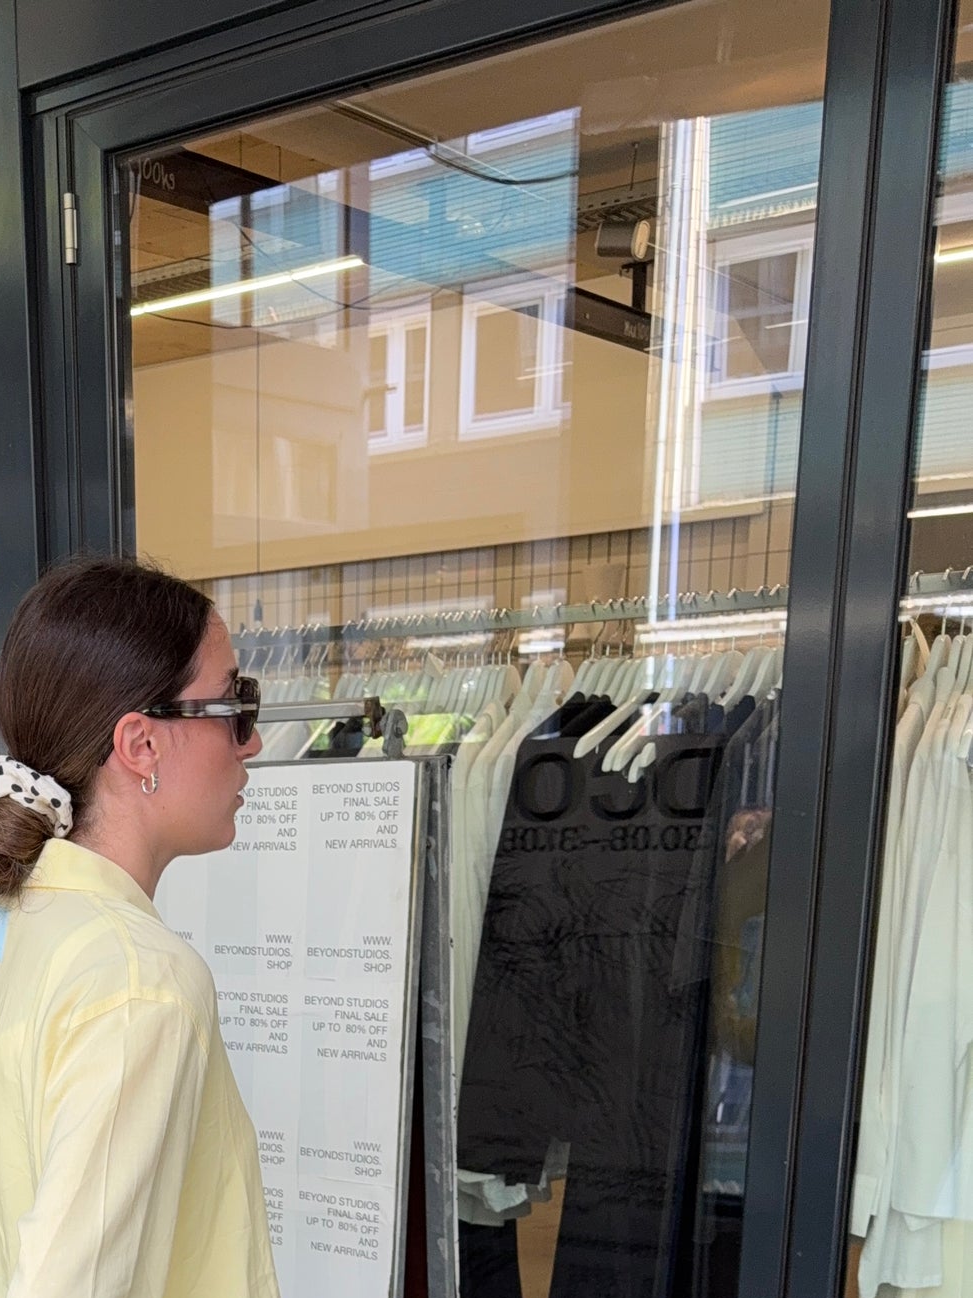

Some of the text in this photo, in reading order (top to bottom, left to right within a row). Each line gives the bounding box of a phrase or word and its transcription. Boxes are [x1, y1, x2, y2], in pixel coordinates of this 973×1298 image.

[256, 786, 298, 798] STUDIOS
[312, 781, 400, 794] BEYOND STUDIOS
[246, 800, 298, 811] FINAL SALE
[343, 796, 399, 808] FINAL SALE
[240, 814, 253, 825] TO
[256, 814, 277, 825] 80%
[278, 813, 298, 824] OFF
[320, 810, 399, 822] UP TO 80% OFF
[276, 827, 298, 838] AND
[376, 824, 398, 835] AND
[252, 840, 297, 851] ARRIVALS
[325, 838, 397, 849] NEW ARRIVALS
[265, 934, 293, 944] WWW.
[363, 936, 393, 946] WWW.
[214, 944, 293, 957] BEYONDSTUDIOS.
[307, 947, 392, 960] BEYONDSTUDIOS.
[267, 960, 292, 970] SHOP
[363, 962, 392, 973] SHOP
[217, 991, 289, 1004] EYOND STUDIOS
[304, 995, 389, 1009] BEYOND STUDIOS
[239, 1004, 288, 1017] FINAL SALE
[334, 1010, 389, 1022] FINAL SALE
[219, 1016, 288, 1029] UP TO 80% OFF
[312, 1021, 387, 1035] UP TO 80% OFF
[268, 1032, 288, 1042] AND
[366, 1038, 387, 1048] AND
[245, 1042, 288, 1054] ARRIVALS
[317, 1048, 387, 1062] NEW ARRIVALS
[353, 1141, 382, 1152] WWW.
[260, 1154, 285, 1165] SHOP
[300, 1146, 382, 1166] BEYONDSTUDIOS.
[355, 1166, 382, 1178] SHOP
[299, 1190, 381, 1212] BEYOND STUDIOS
[327, 1207, 381, 1224] FINAL SALE
[306, 1216, 379, 1236] UP TO 80% OFF
[358, 1237, 379, 1248] AND
[310, 1241, 378, 1261] NEW ARRIVALS
